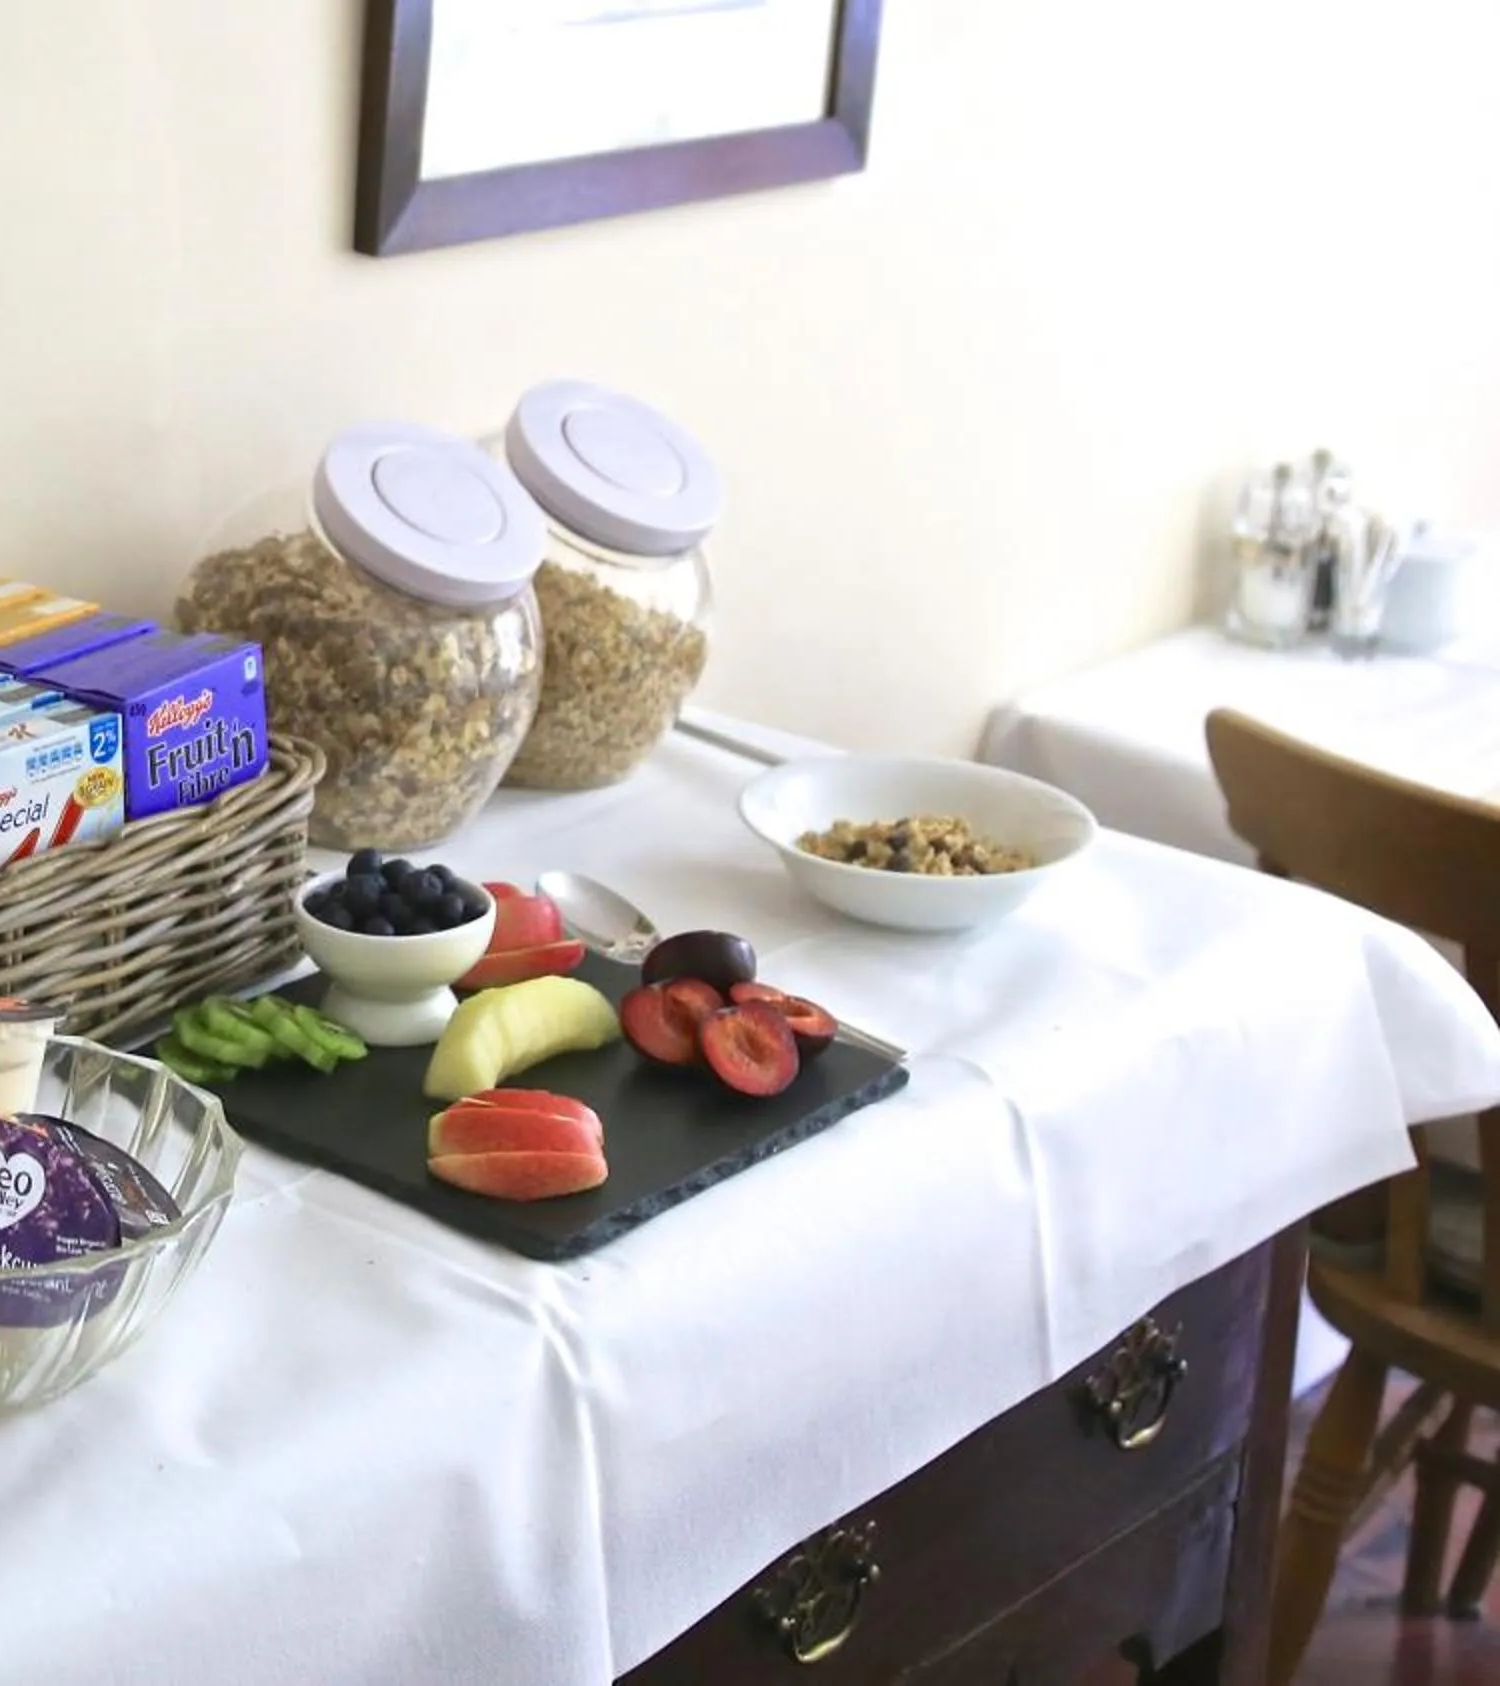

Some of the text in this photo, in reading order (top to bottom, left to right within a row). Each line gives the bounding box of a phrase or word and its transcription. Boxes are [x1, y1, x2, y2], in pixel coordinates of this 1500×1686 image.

[147, 688, 214, 738] Kellogg's
[148, 717, 228, 789] Fruit
[178, 766, 231, 804] Fibre
